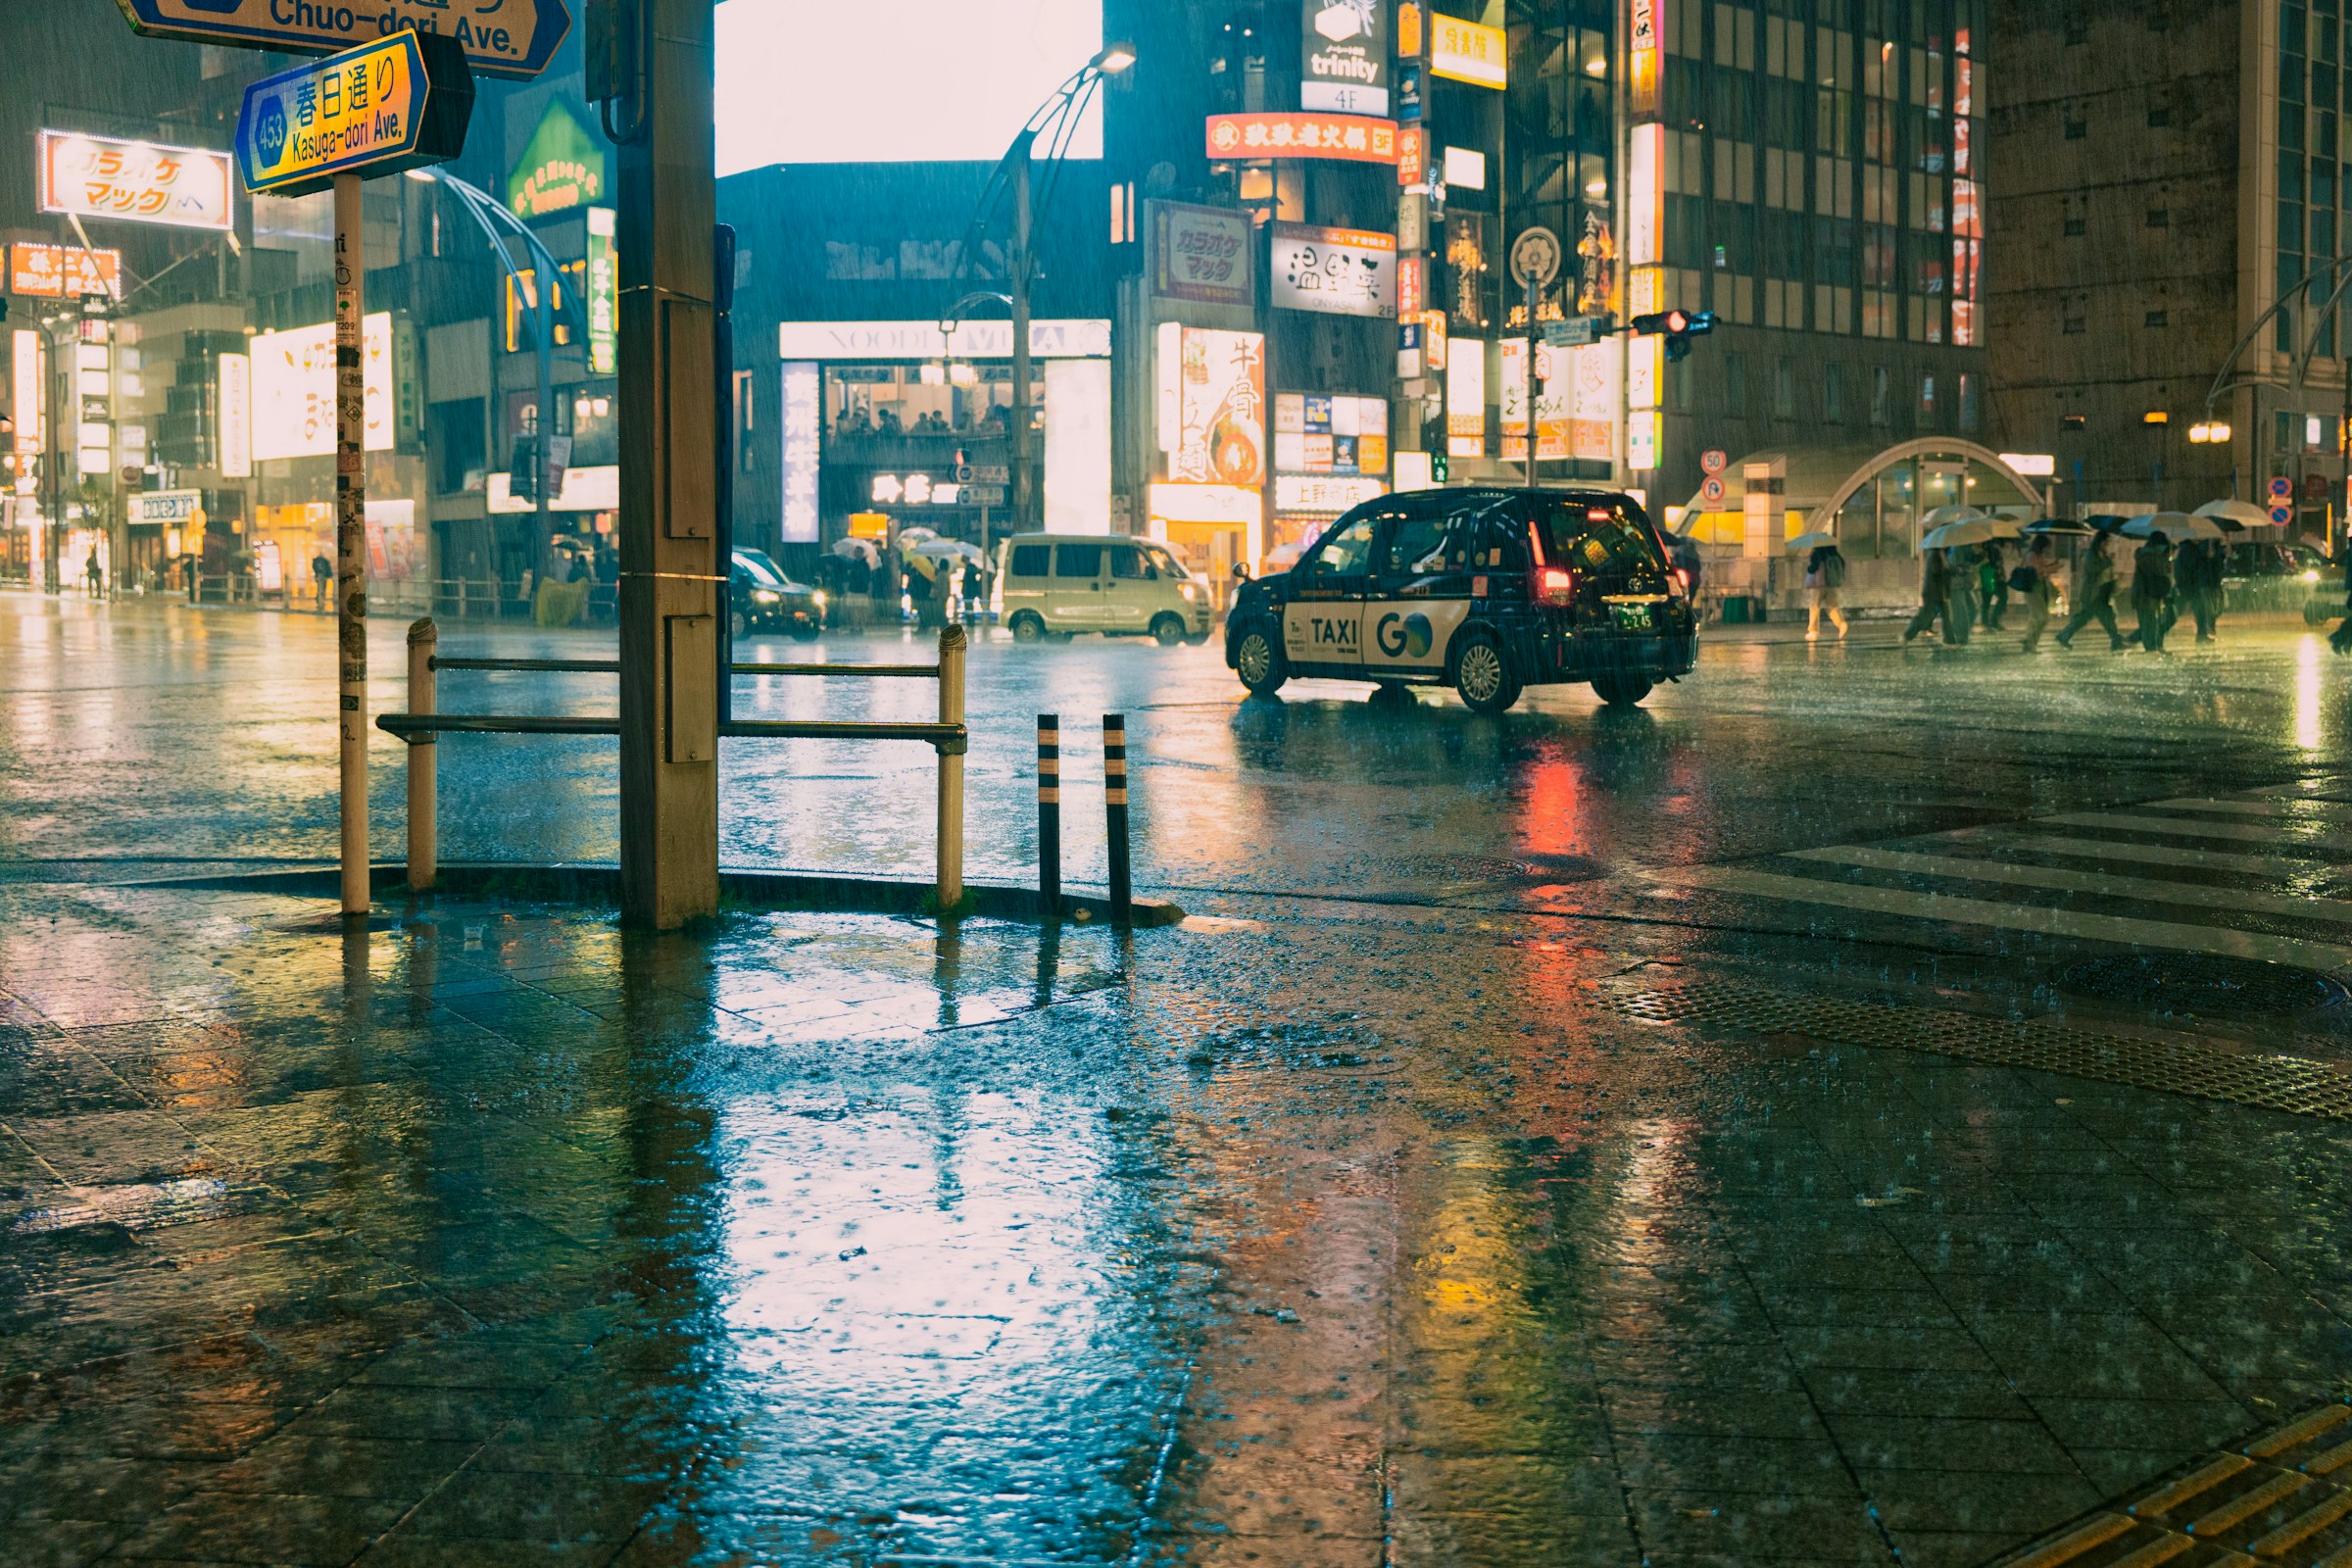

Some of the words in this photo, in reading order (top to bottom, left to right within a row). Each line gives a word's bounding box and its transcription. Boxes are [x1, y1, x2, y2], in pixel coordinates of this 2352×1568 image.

[270, 0, 438, 35] Chuo-dori
[455, 16, 518, 56] Ave.
[1310, 53, 1379, 84] trinity
[295, 56, 395, 126] 春日通り
[1334, 89, 1357, 110] 4F
[259, 113, 284, 151] 453
[293, 114, 368, 163] Kasuga-dori
[373, 110, 403, 139] Ave.
[1374, 133, 1393, 149] 3F
[84, 181, 170, 216] マック
[1175, 228, 1243, 259] カラオケ
[1187, 255, 1234, 283] マック
[1287, 246, 1381, 301] 温野菜
[1378, 305, 1396, 317] 2F
[1230, 337, 1257, 421] 牛骨
[1706, 454, 1720, 467] 50
[1311, 617, 1357, 645] TAXI
[1377, 612, 1433, 659] GO
